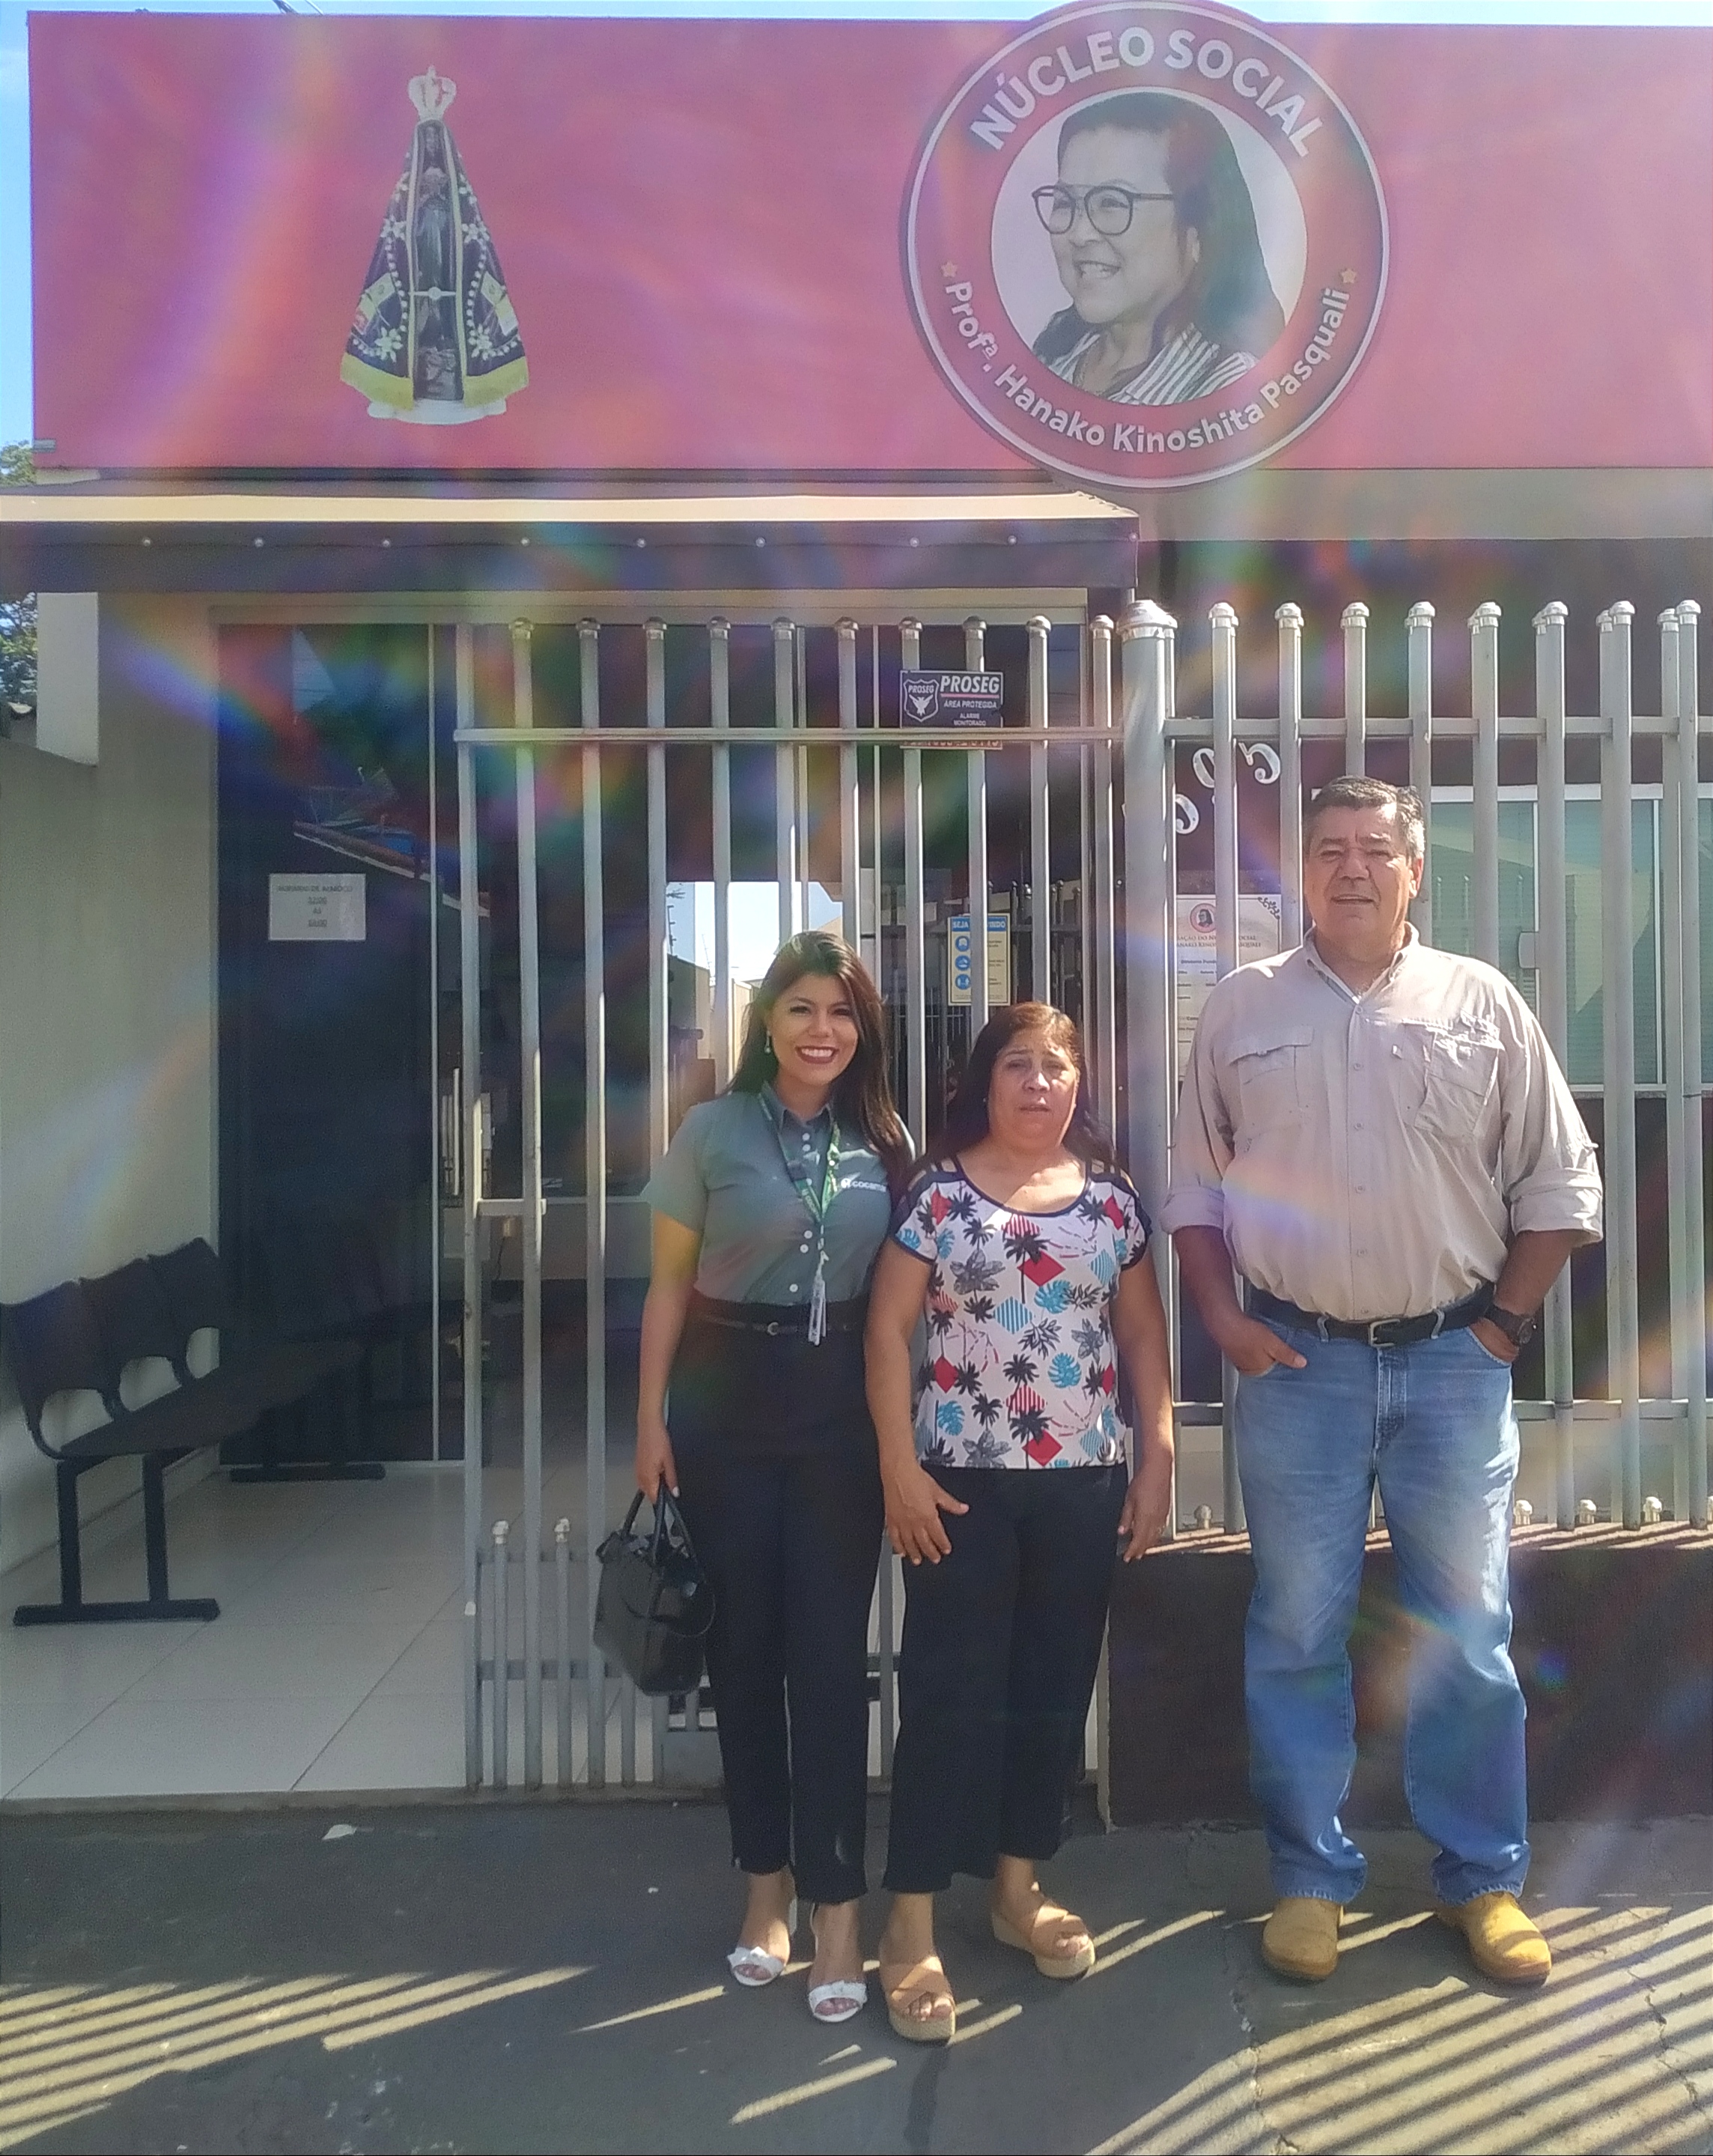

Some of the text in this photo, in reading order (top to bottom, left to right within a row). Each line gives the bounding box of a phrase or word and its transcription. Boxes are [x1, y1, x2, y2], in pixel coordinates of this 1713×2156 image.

[970, 26, 1323, 157] NÚCLEO SOCIAL
[994, 364, 1105, 446] Hanako
[1113, 403, 1265, 452] Kinoshita
[1260, 288, 1349, 408] Pasquali
[908, 685, 934, 693] PROSEG
[940, 675, 1000, 693] PROSEG
[961, 700, 997, 708] PROTEGIDA
